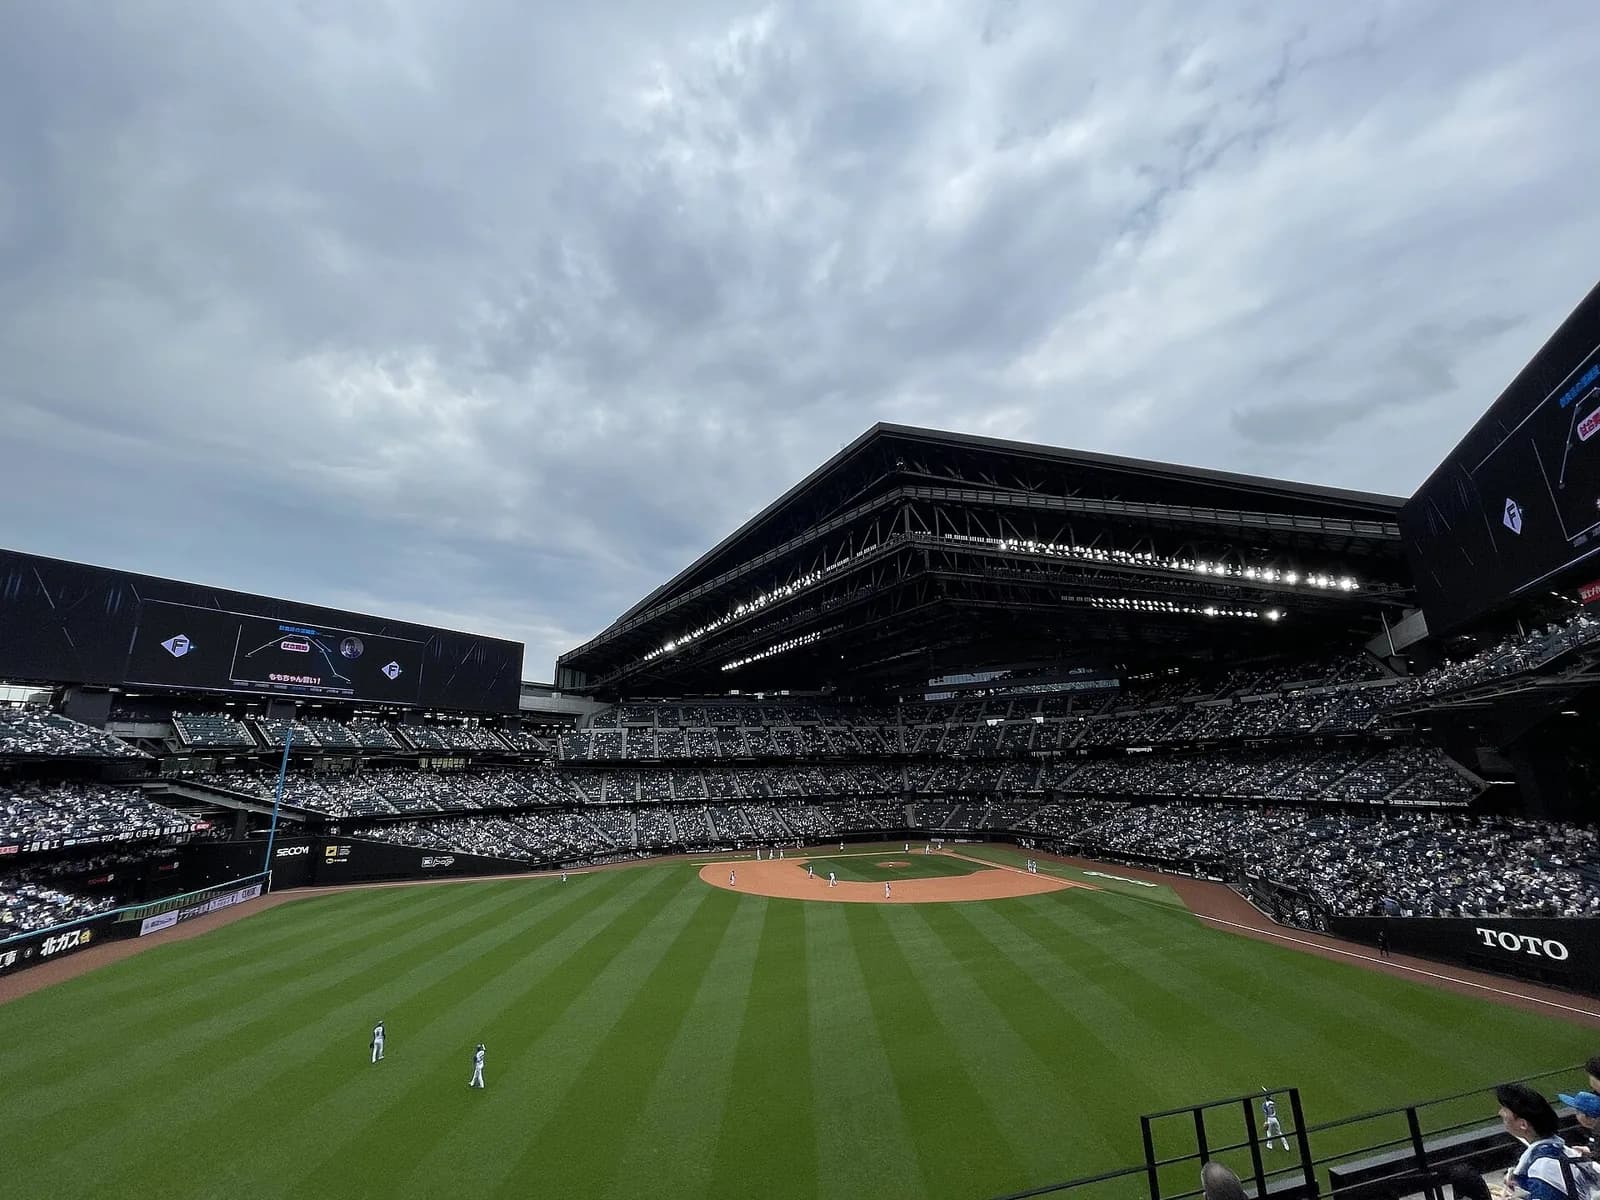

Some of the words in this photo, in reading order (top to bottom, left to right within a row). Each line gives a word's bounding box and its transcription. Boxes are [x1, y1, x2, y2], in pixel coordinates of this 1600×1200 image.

[40, 930, 81, 956] 北ガス
[1475, 927, 1569, 961] TOTO
